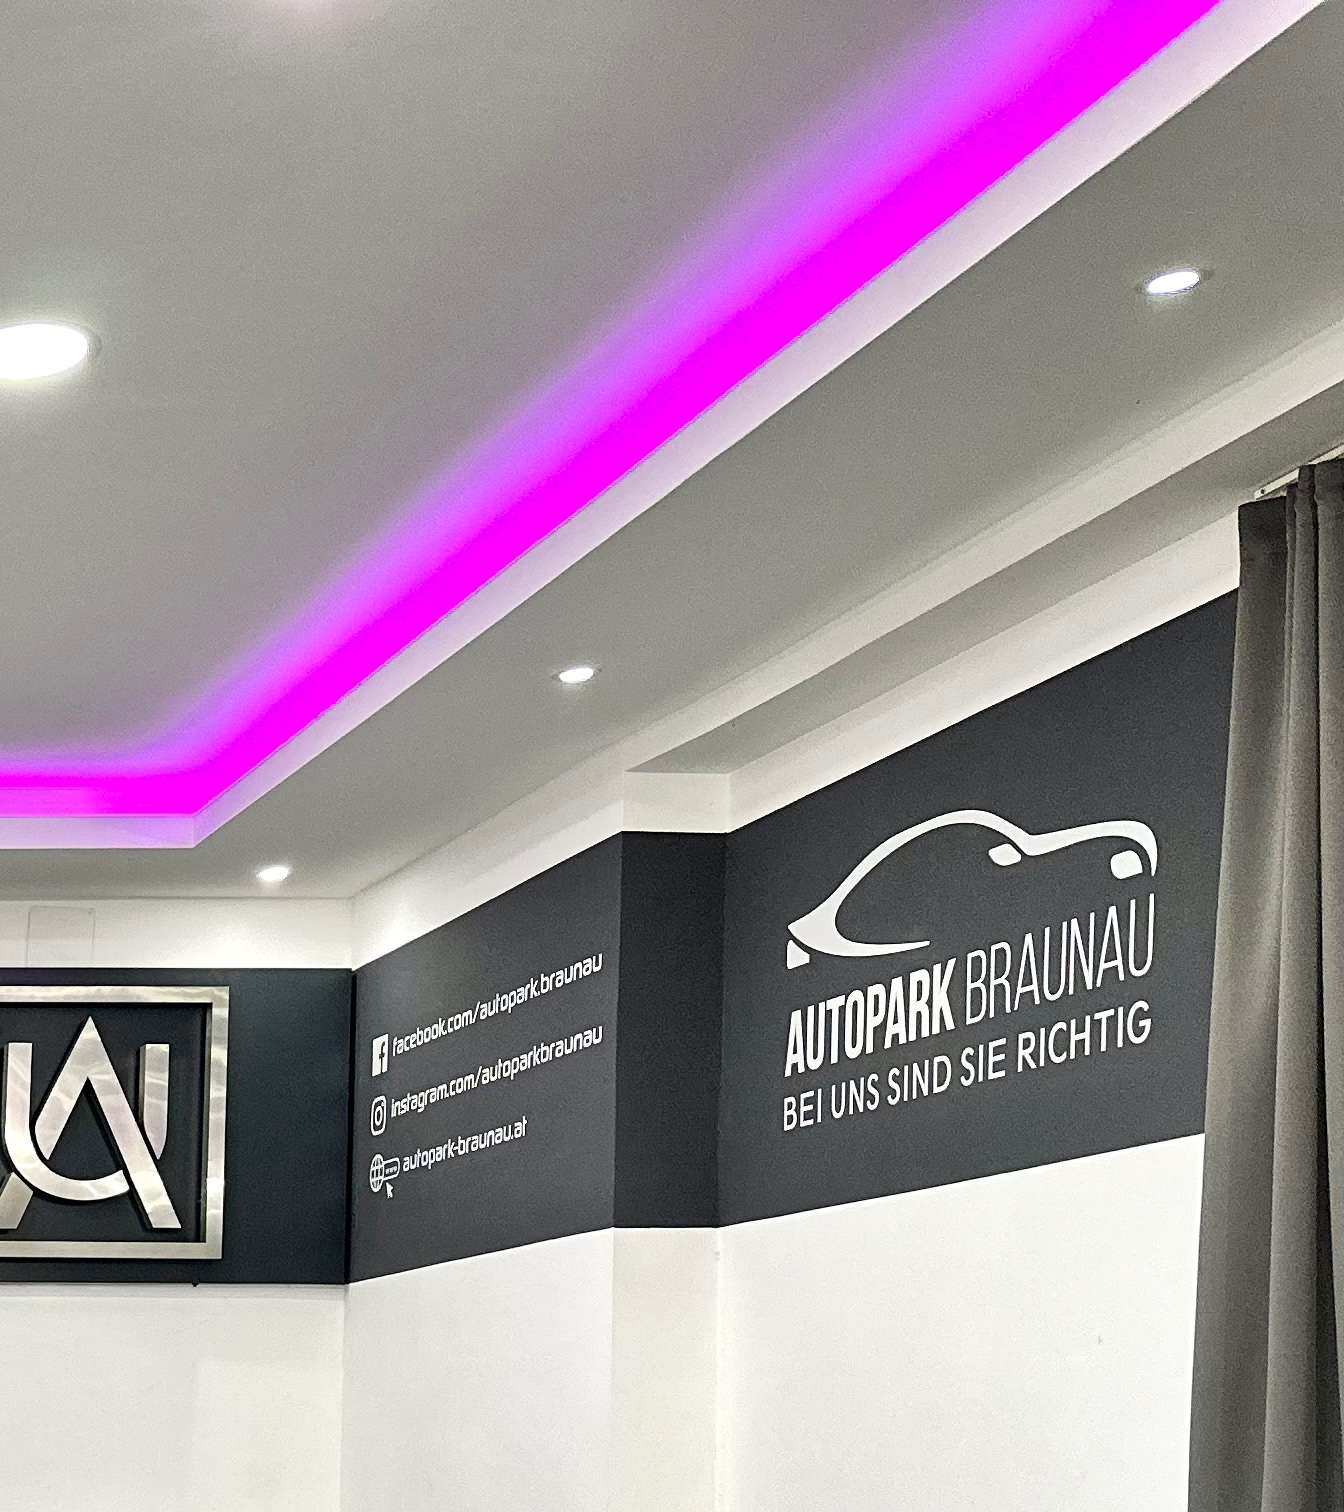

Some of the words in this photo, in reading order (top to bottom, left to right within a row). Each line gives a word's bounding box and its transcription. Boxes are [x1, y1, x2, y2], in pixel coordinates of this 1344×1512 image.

[392, 953, 603, 1056] facebook.com/autopark.braunau
[784, 957, 957, 1077] AUTOPARK
[965, 893, 1155, 1025] BRAUNAU
[390, 1025, 603, 1119] instagram.com/autoparkbraunau
[783, 1088, 823, 1132] BEI
[831, 1073, 881, 1119] UNS
[887, 1055, 952, 1106] SIND
[960, 1038, 1007, 1086] SIE
[1017, 1000, 1152, 1073] RICHTIG
[402, 1116, 528, 1172] autopark-braunau.at
